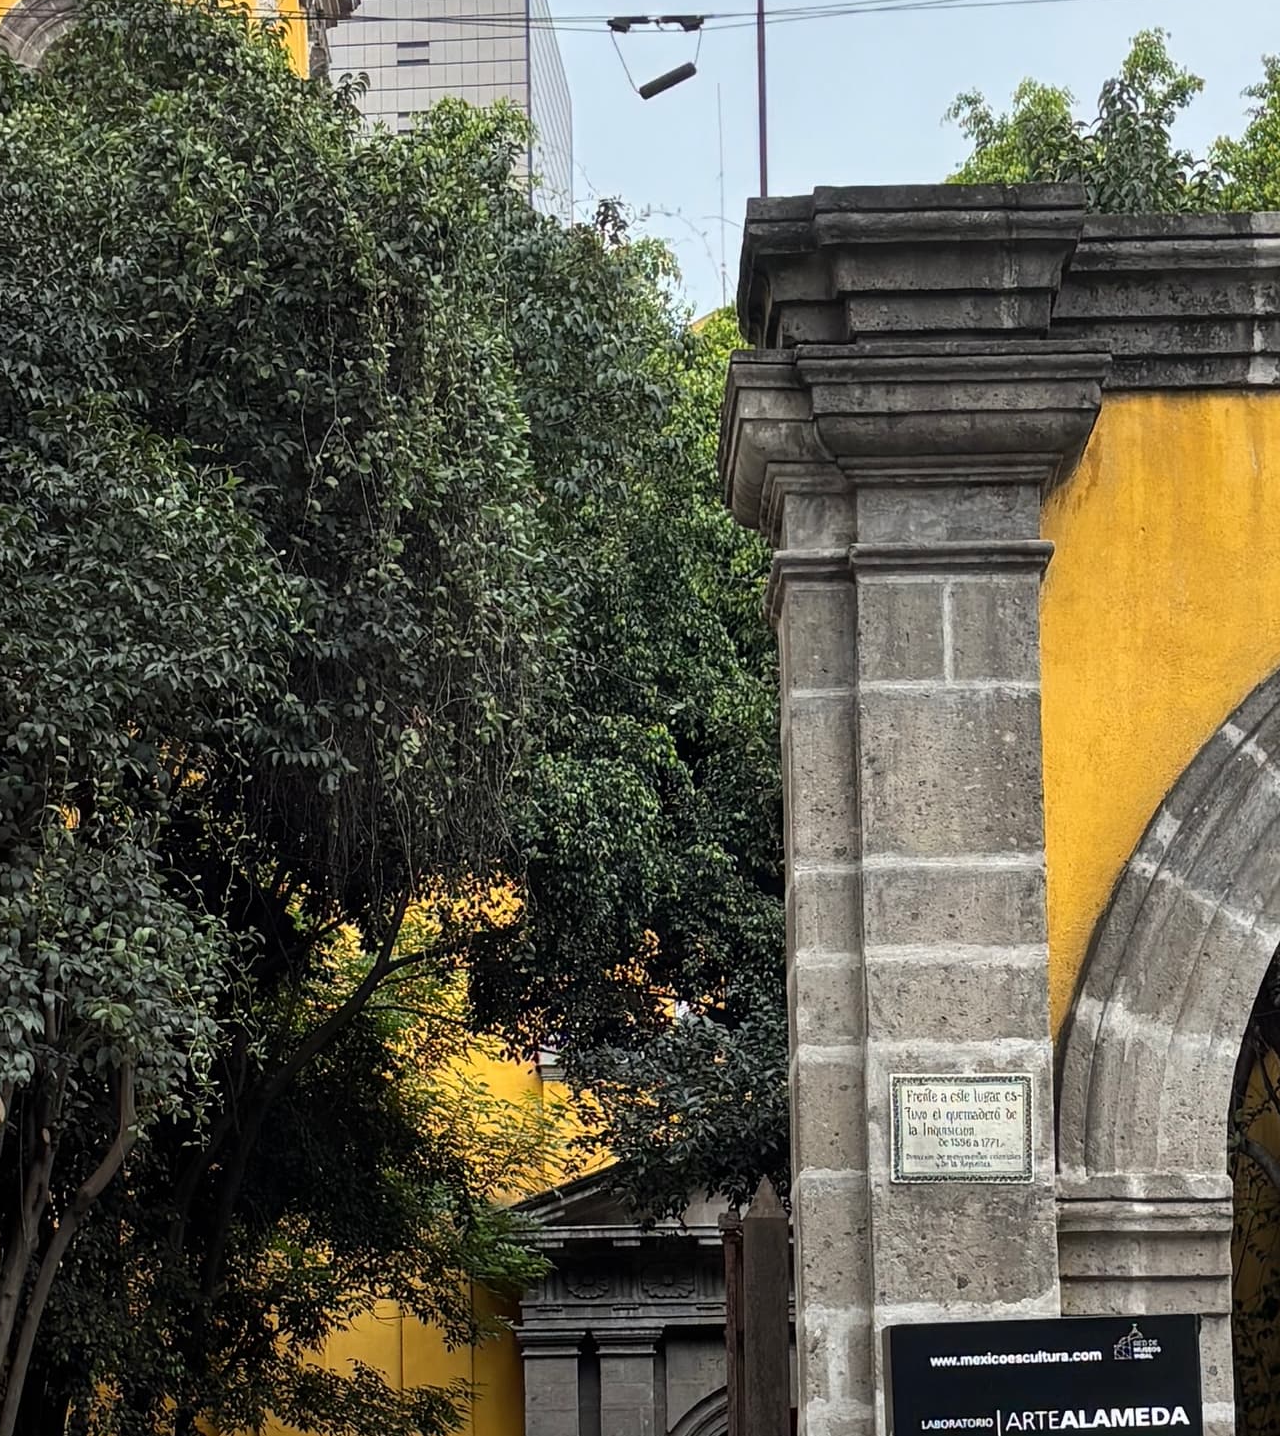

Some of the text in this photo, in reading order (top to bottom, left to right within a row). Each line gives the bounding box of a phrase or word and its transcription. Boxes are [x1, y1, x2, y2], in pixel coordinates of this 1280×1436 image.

[906, 1088, 1023, 1104] Frente a este lugar es-
[932, 1108, 942, 1120] el
[1006, 1108, 1018, 1120] de
[908, 1123, 918, 1136] la
[938, 1138, 949, 1148] de
[930, 1350, 1102, 1367] www.mexicoescultura.com
[921, 1417, 993, 1430] LABORATORIO
